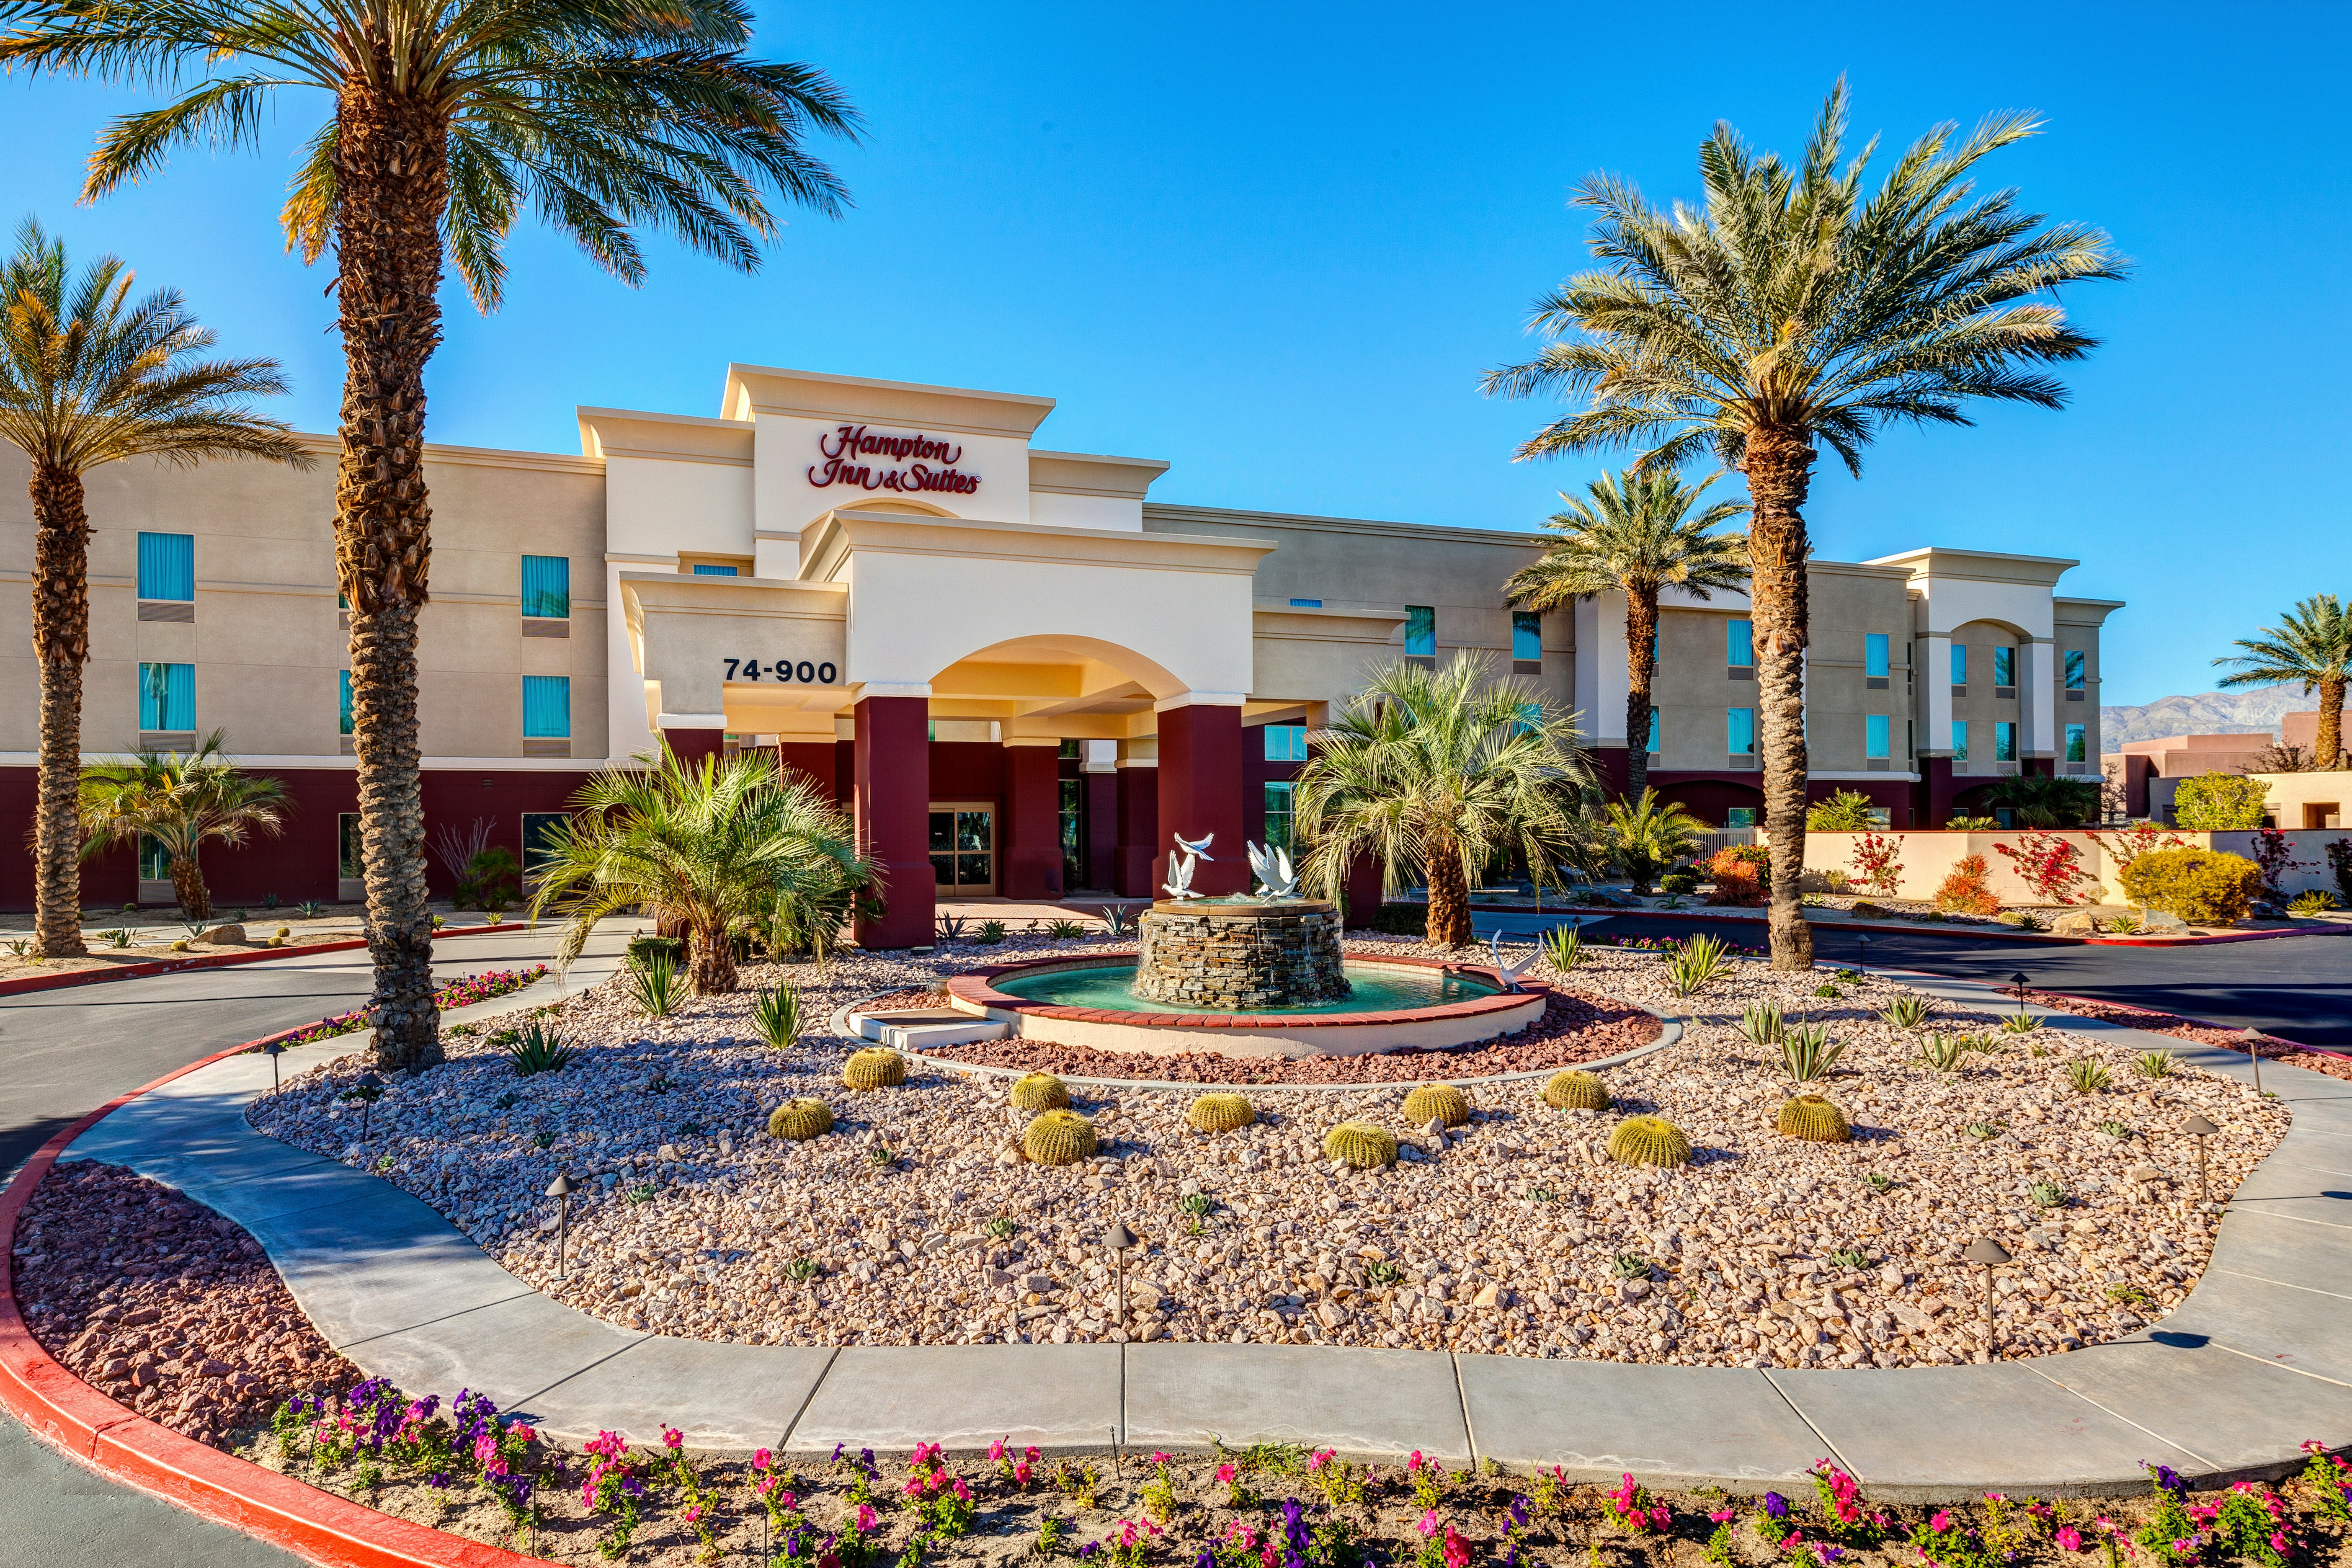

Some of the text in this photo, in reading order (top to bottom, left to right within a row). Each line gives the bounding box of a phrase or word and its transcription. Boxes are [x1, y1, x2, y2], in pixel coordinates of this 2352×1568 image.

[821, 426, 962, 464] Hampton
[808, 459, 883, 490] Inn
[884, 470, 903, 492] &
[723, 658, 837, 683] 74-900
